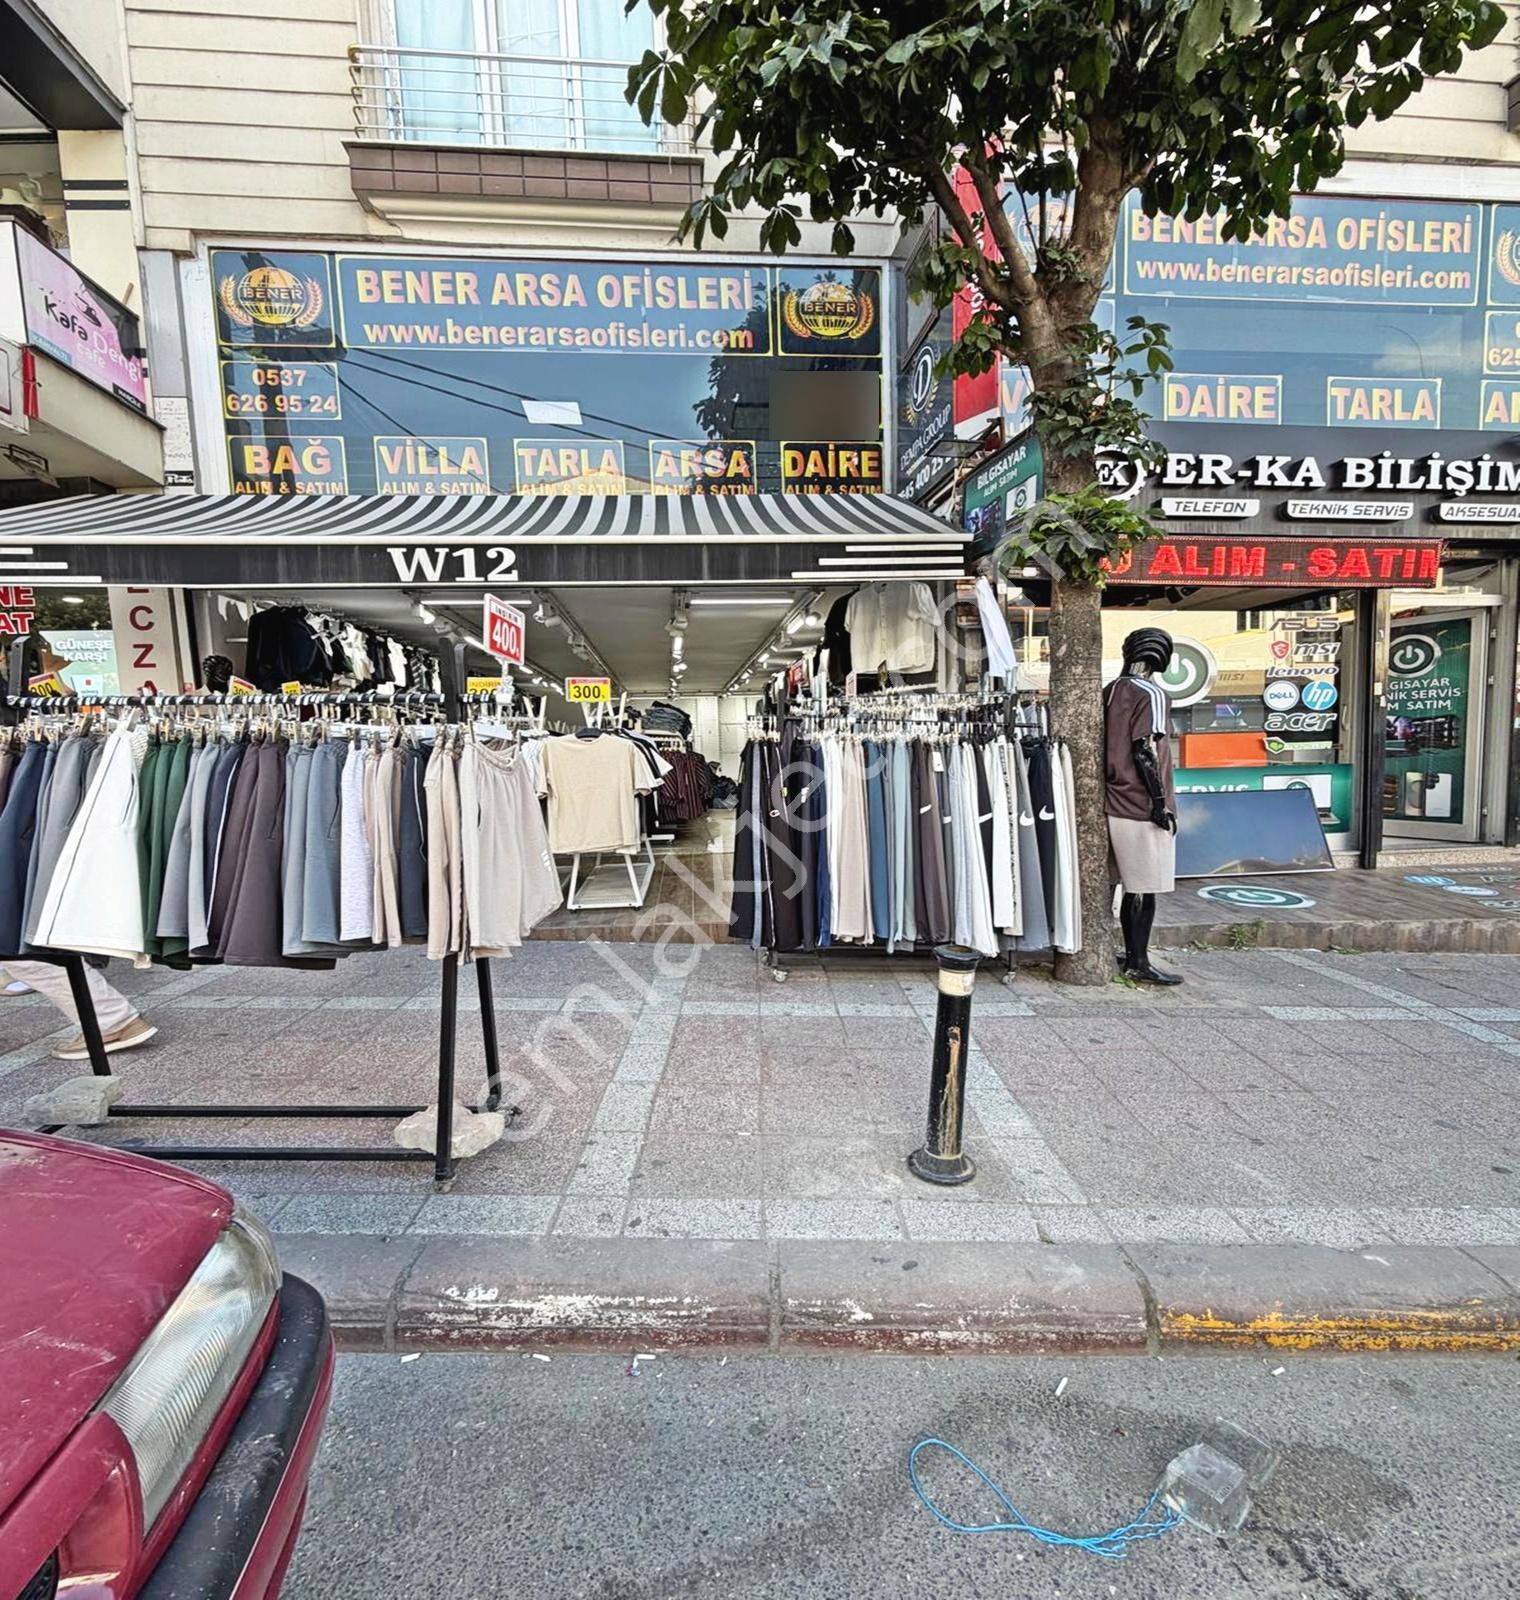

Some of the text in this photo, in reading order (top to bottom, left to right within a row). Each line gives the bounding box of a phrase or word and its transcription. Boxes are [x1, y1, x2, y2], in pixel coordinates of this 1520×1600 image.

[1337, 212, 1472, 253] OFİSLERİ
[1136, 258, 1471, 289] www.benerarsaofisleri.com
[243, 287, 304, 301] BENER
[356, 267, 752, 311] BENER ARSA OFİSLERİ
[804, 301, 858, 314] BENER
[44, 294, 89, 342] Kafa
[363, 318, 754, 349] www.benerarsaofisleri.com
[252, 368, 307, 387] 0537
[226, 394, 338, 413] 626 95 24
[1168, 378, 1277, 420] DAİRE
[1330, 387, 1436, 422] TARLA
[243, 438, 332, 475] BAĞ
[378, 438, 484, 475] VİLLA
[517, 447, 620, 477] TARLA
[655, 449, 751, 478] ARSA
[784, 443, 881, 478] DAİRE
[1162, 450, 1520, 497] ER-KA BİLİŞİM
[235, 481, 345, 495] ALIM & SATIM
[382, 481, 488, 495] ALIM & SATIM
[520, 483, 624, 495] ALIM & SATIM
[696, 484, 705, 495] &
[710, 484, 754, 495] SATIM
[786, 484, 881, 495] ALIM & SATIM
[1174, 501, 1247, 514] TELEFON
[1444, 506, 1520, 519] AKSESUA
[386, 547, 519, 582] W12
[1148, 545, 1267, 577] ALIM
[1268, 617, 1340, 632] ASUS
[55, 638, 113, 652] GÜNEŞE
[492, 618, 517, 655] 400
[1267, 666, 1339, 677] lenovo
[573, 685, 601, 699] 300
[1269, 691, 1295, 700] DELL
[1306, 680, 1334, 709] hp
[1411, 686, 1462, 700] SERVİS
[1407, 699, 1452, 711] SATIM
[1264, 712, 1338, 732] acer
